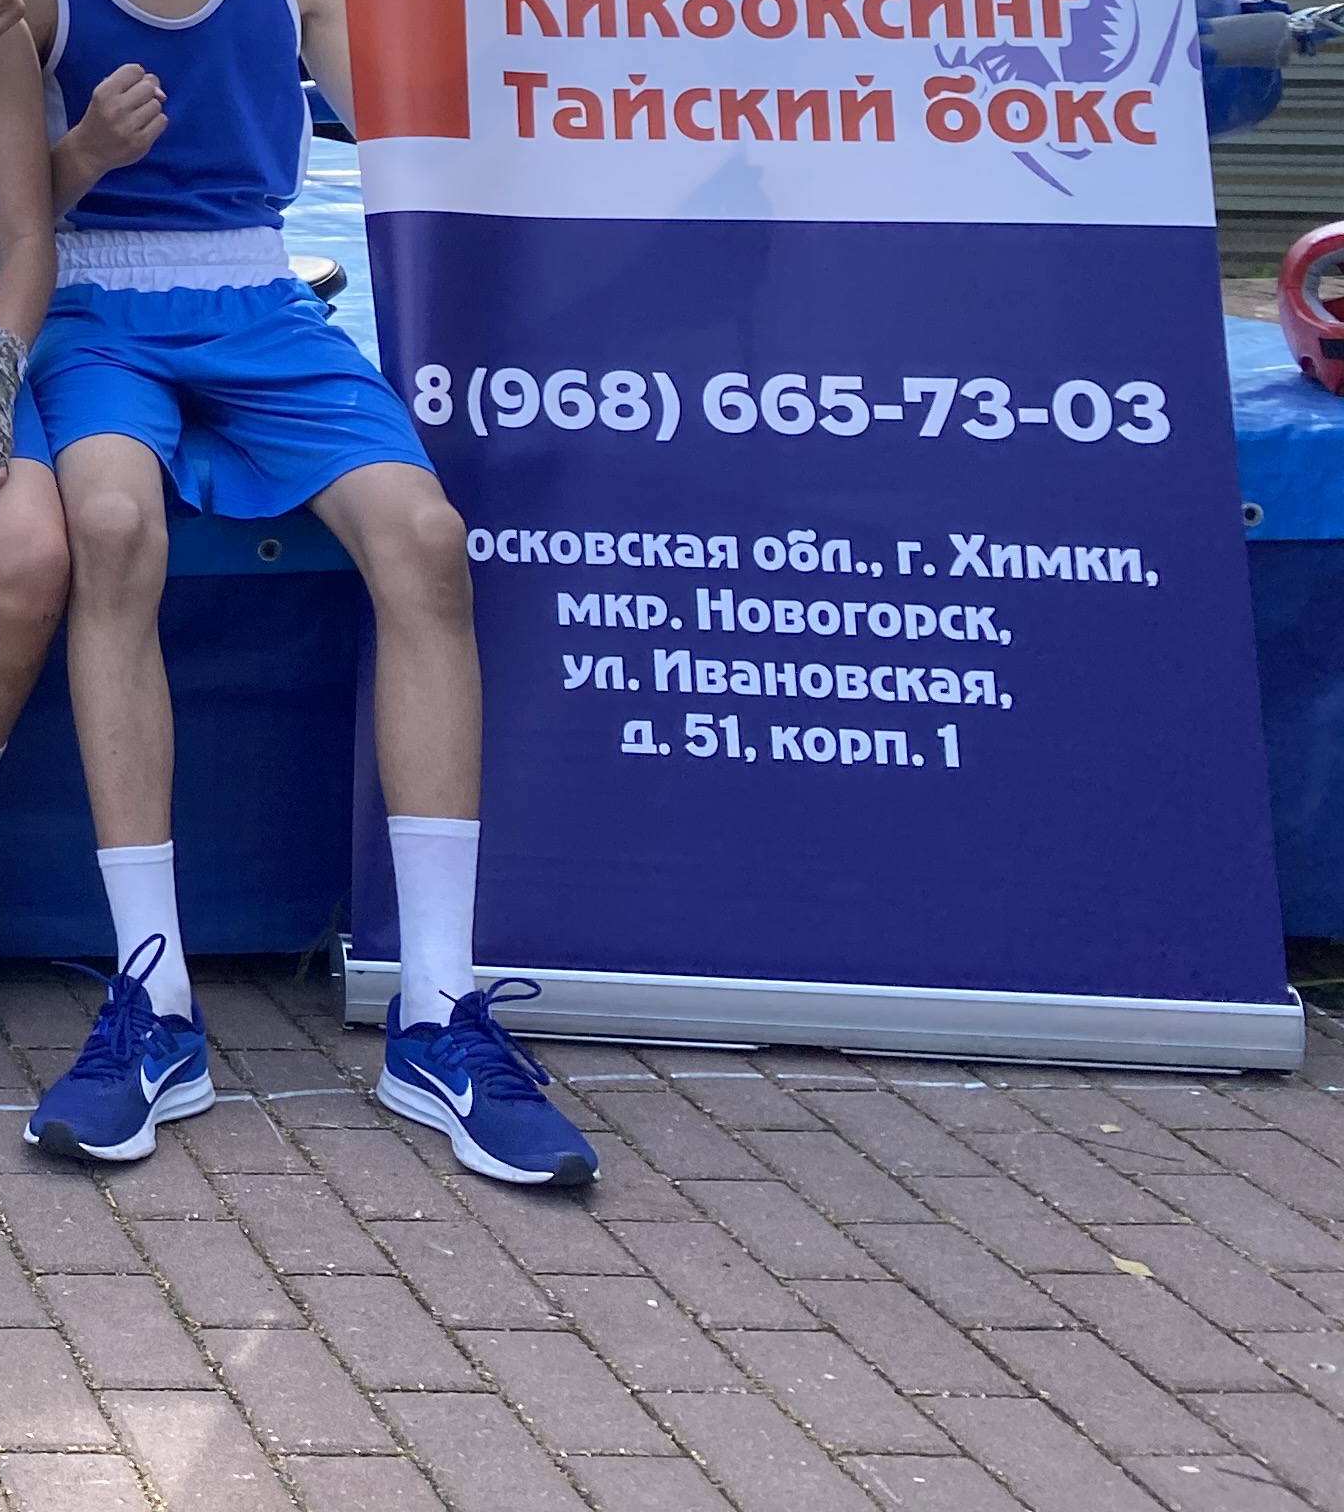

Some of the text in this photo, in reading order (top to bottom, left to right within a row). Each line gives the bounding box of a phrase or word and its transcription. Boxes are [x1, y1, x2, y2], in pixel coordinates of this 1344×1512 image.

[502, 70, 1156, 144] Тайский бокс
[413, 364, 1172, 444] 8 (968) 665-73-03
[467, 528, 1159, 587] осковская обл., г. Химки,
[557, 588, 1013, 646] мкр. Новогорск,
[562, 648, 1014, 710] ул. Ивановская,
[621, 713, 961, 768] д. 51, корп. 1
